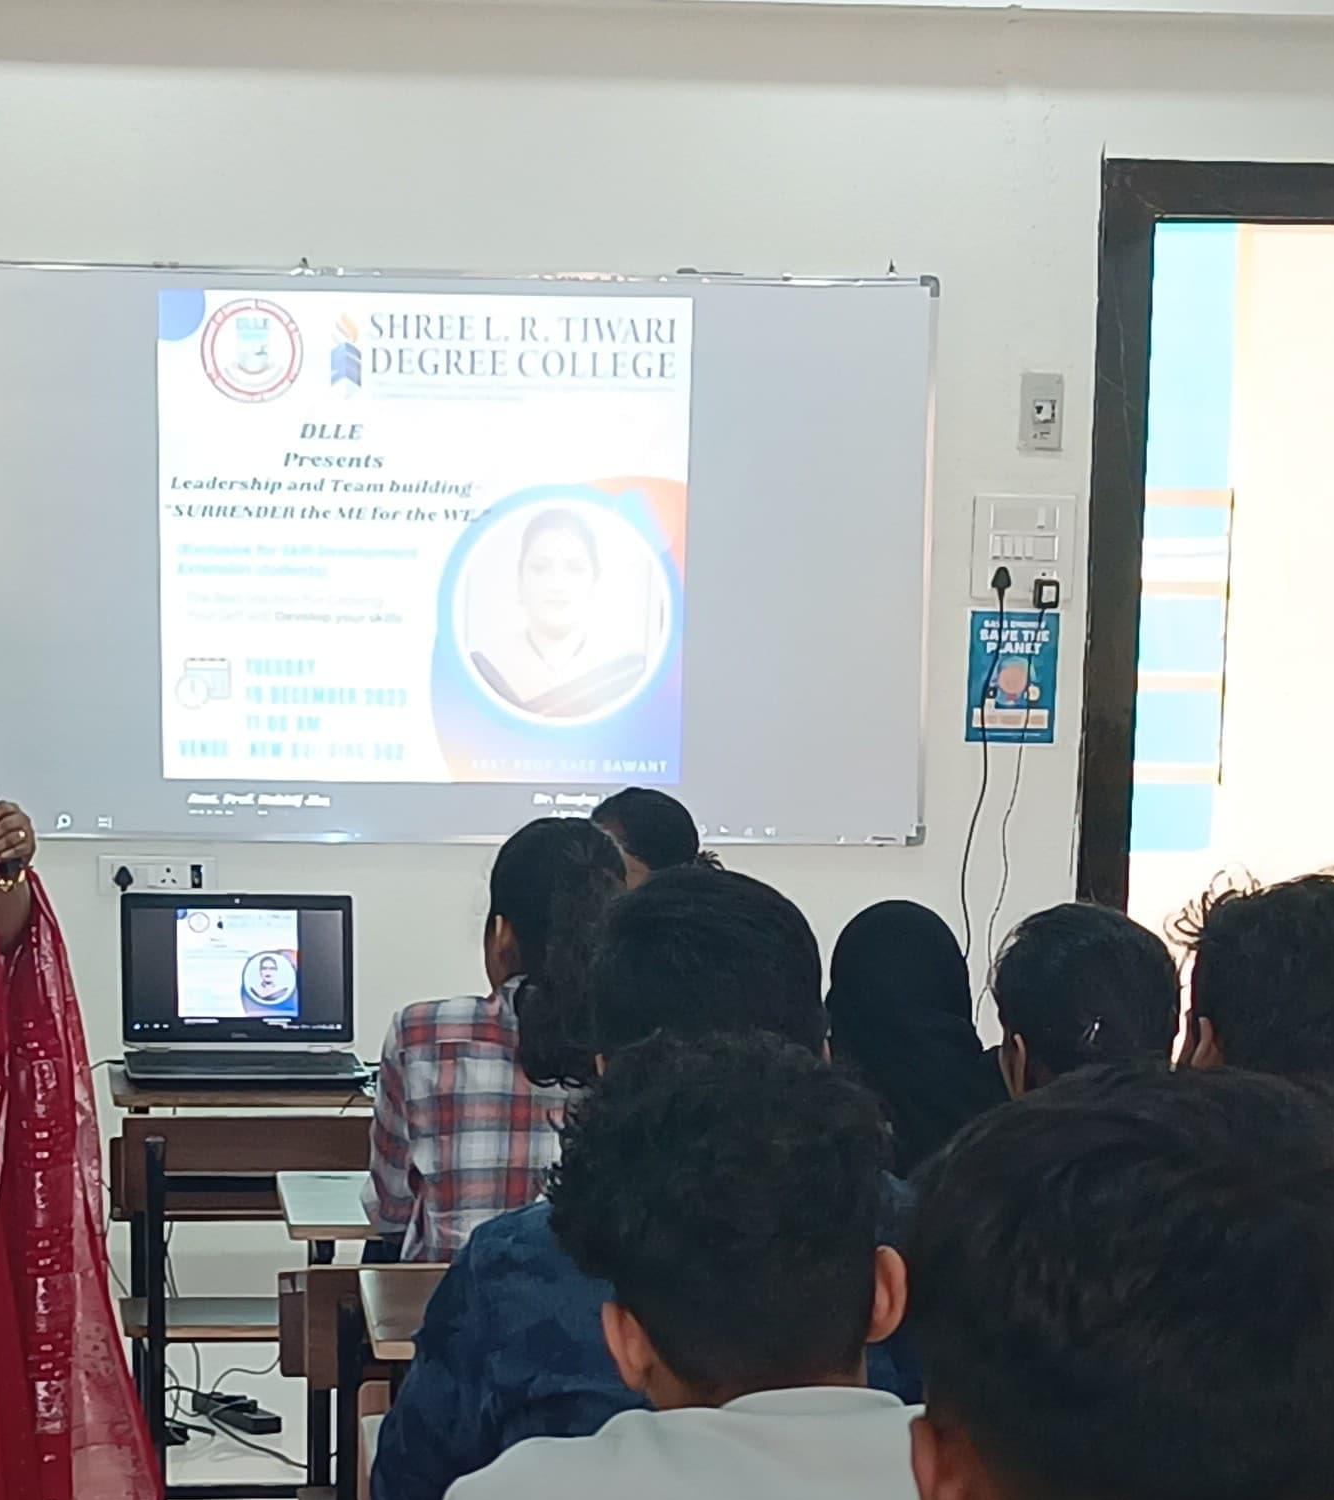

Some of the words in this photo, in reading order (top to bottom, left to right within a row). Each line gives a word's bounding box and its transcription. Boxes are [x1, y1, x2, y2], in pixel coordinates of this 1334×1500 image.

[369, 312, 476, 342] SHREE
[484, 315, 510, 342] L.
[520, 316, 550, 343] R.
[558, 316, 676, 344] TIWARI
[370, 347, 508, 377] DEGREE
[517, 349, 677, 379] COLLEGE
[299, 423, 364, 440] DLLE
[283, 452, 385, 469] Presents
[170, 476, 283, 495] Leadership
[286, 478, 325, 493] and
[330, 478, 385, 494] Team
[300, 504, 332, 520] the
[335, 506, 366, 520] ME
[370, 505, 403, 521] for
[405, 506, 438, 522] the
[979, 628, 1019, 641] SAVE
[1022, 629, 1051, 642] THE
[270, 686, 357, 705] DECEMBER
[602, 758, 667, 774] SAWANT
